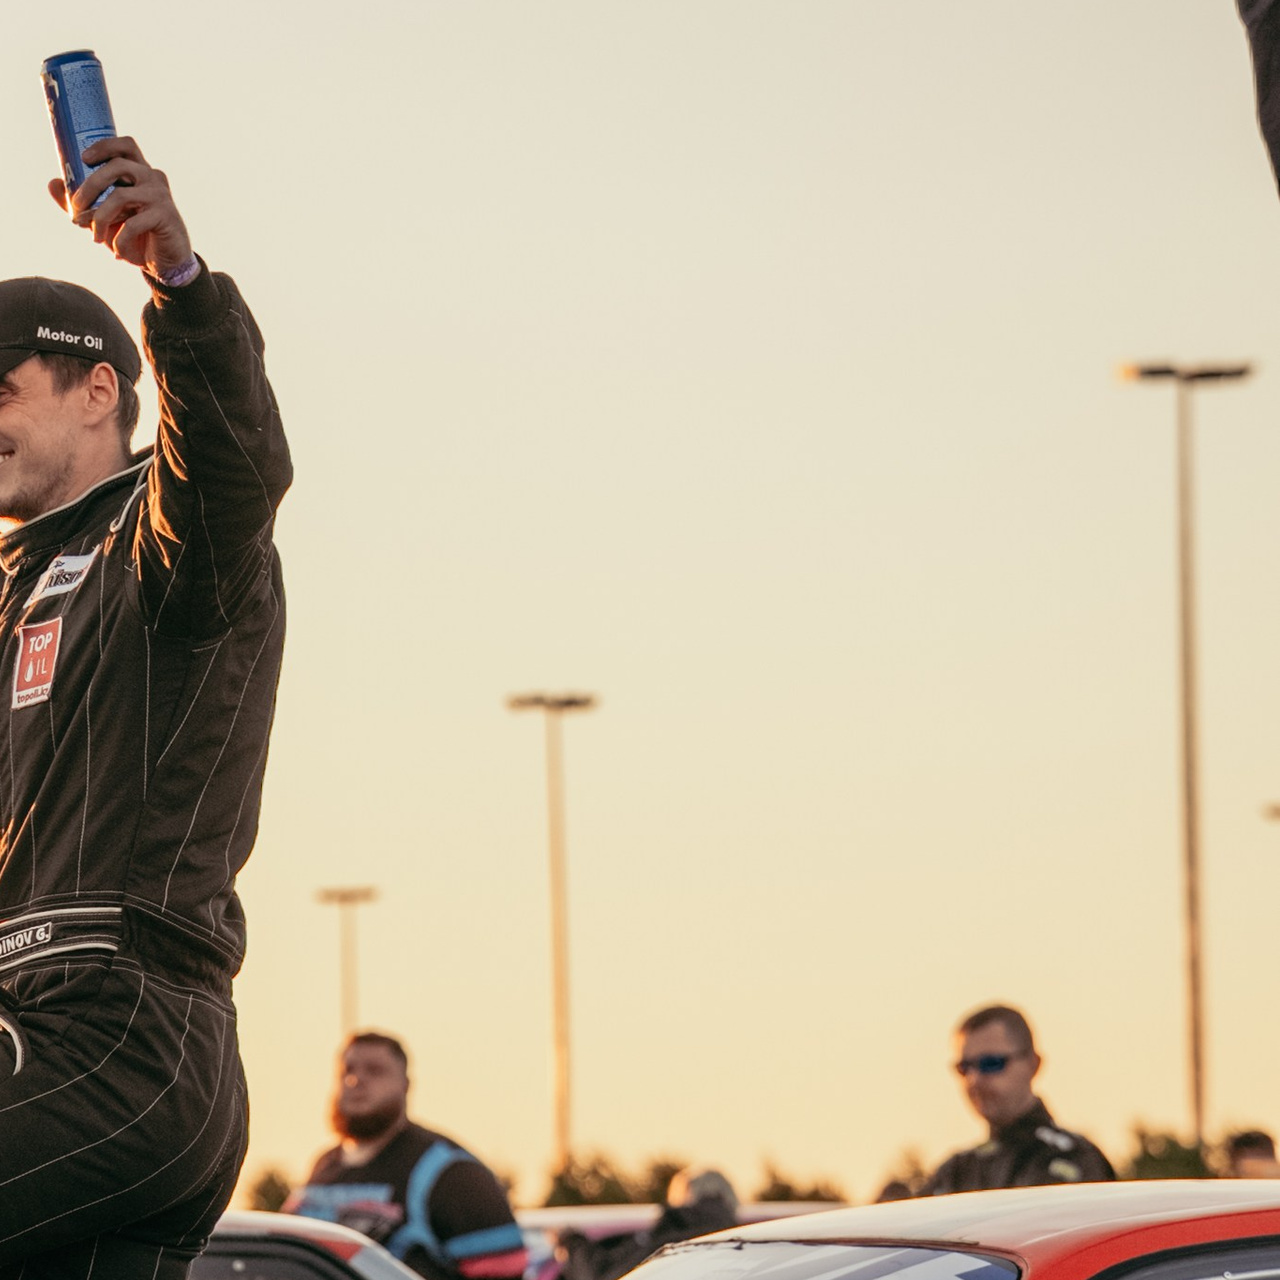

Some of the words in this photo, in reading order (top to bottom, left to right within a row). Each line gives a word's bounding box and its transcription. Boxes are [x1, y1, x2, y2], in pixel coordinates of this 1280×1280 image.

[37, 326, 80, 344] Motor
[84, 335, 103, 351] Oil
[29, 631, 54, 654] TOP
[36, 927, 49, 941] G.
